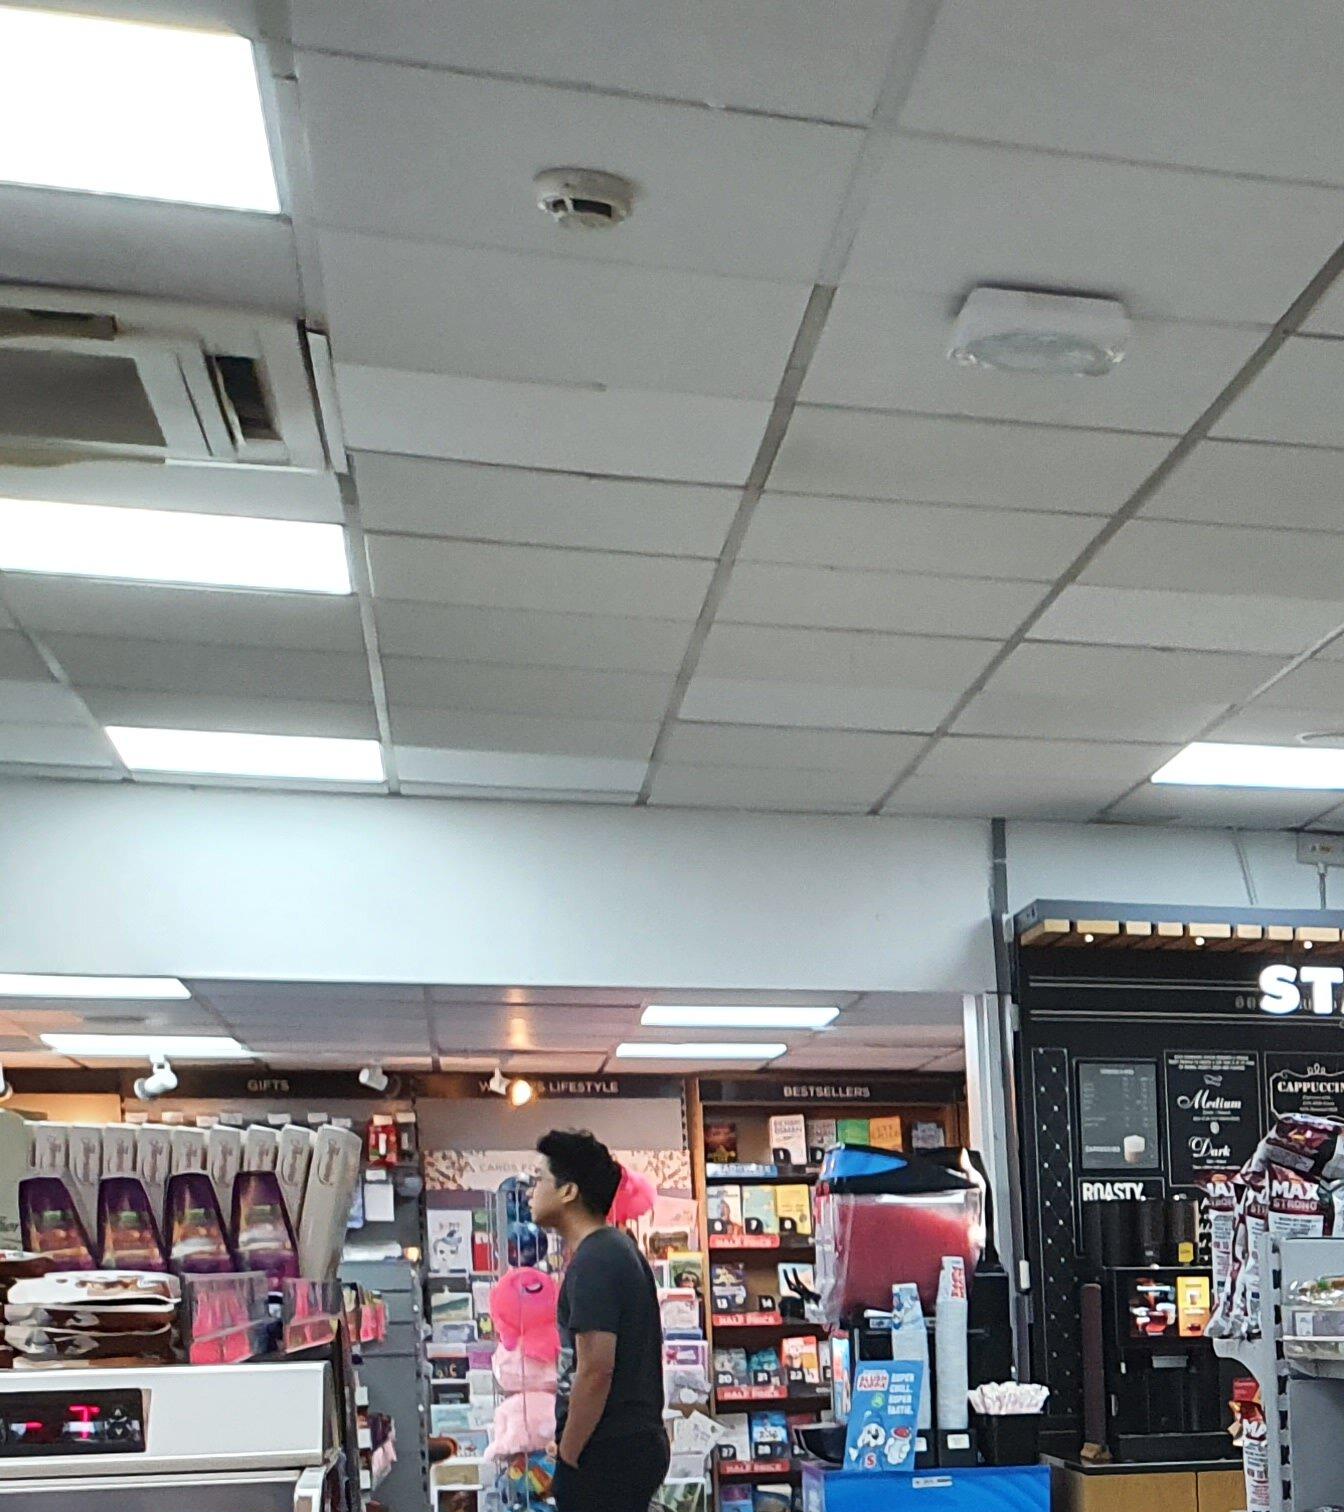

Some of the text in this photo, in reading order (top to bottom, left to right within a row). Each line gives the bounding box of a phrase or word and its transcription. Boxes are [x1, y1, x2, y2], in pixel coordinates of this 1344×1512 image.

[247, 1079, 289, 1092] GIFTS
[549, 1079, 619, 1094] LIFESTYLE
[783, 1086, 870, 1097] BESTSELLERS
[1177, 1089, 1242, 1110] Medium
[1188, 1136, 1231, 1158] Dark
[1271, 1180, 1320, 1200] MAX
